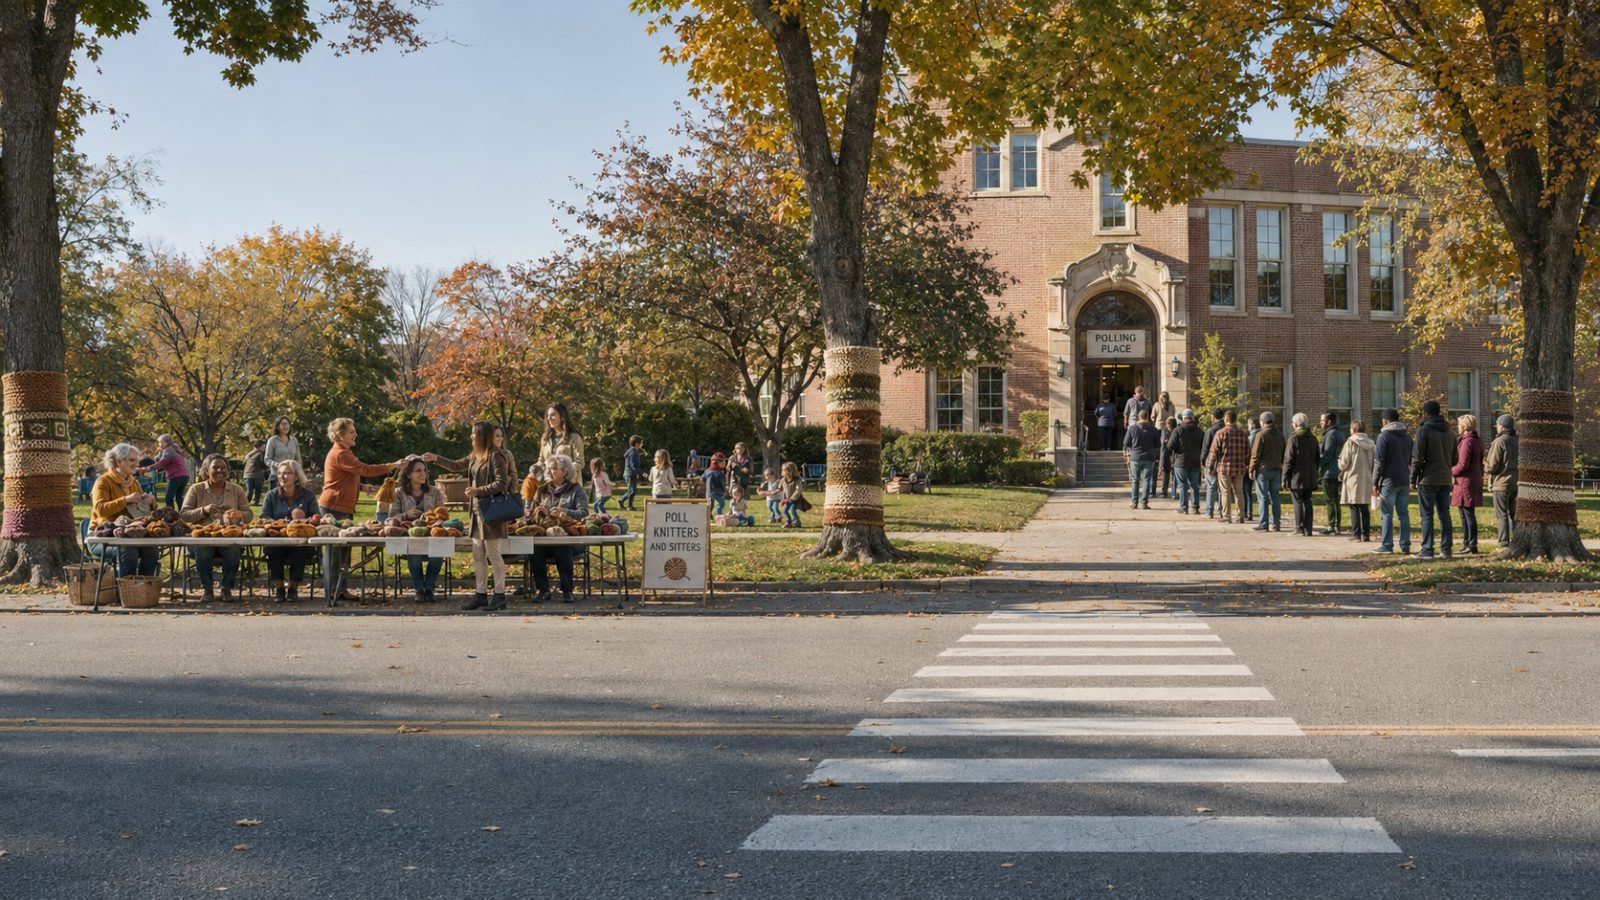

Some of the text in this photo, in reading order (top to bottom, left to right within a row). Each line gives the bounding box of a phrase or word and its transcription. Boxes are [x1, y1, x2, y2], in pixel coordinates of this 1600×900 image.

[1095, 333, 1136, 342] POLLING
[1101, 344, 1131, 353] PLACE
[665, 512, 688, 523] POLL
[653, 526, 699, 538] KNITTERS
[650, 542, 701, 552] AND SITTERS
